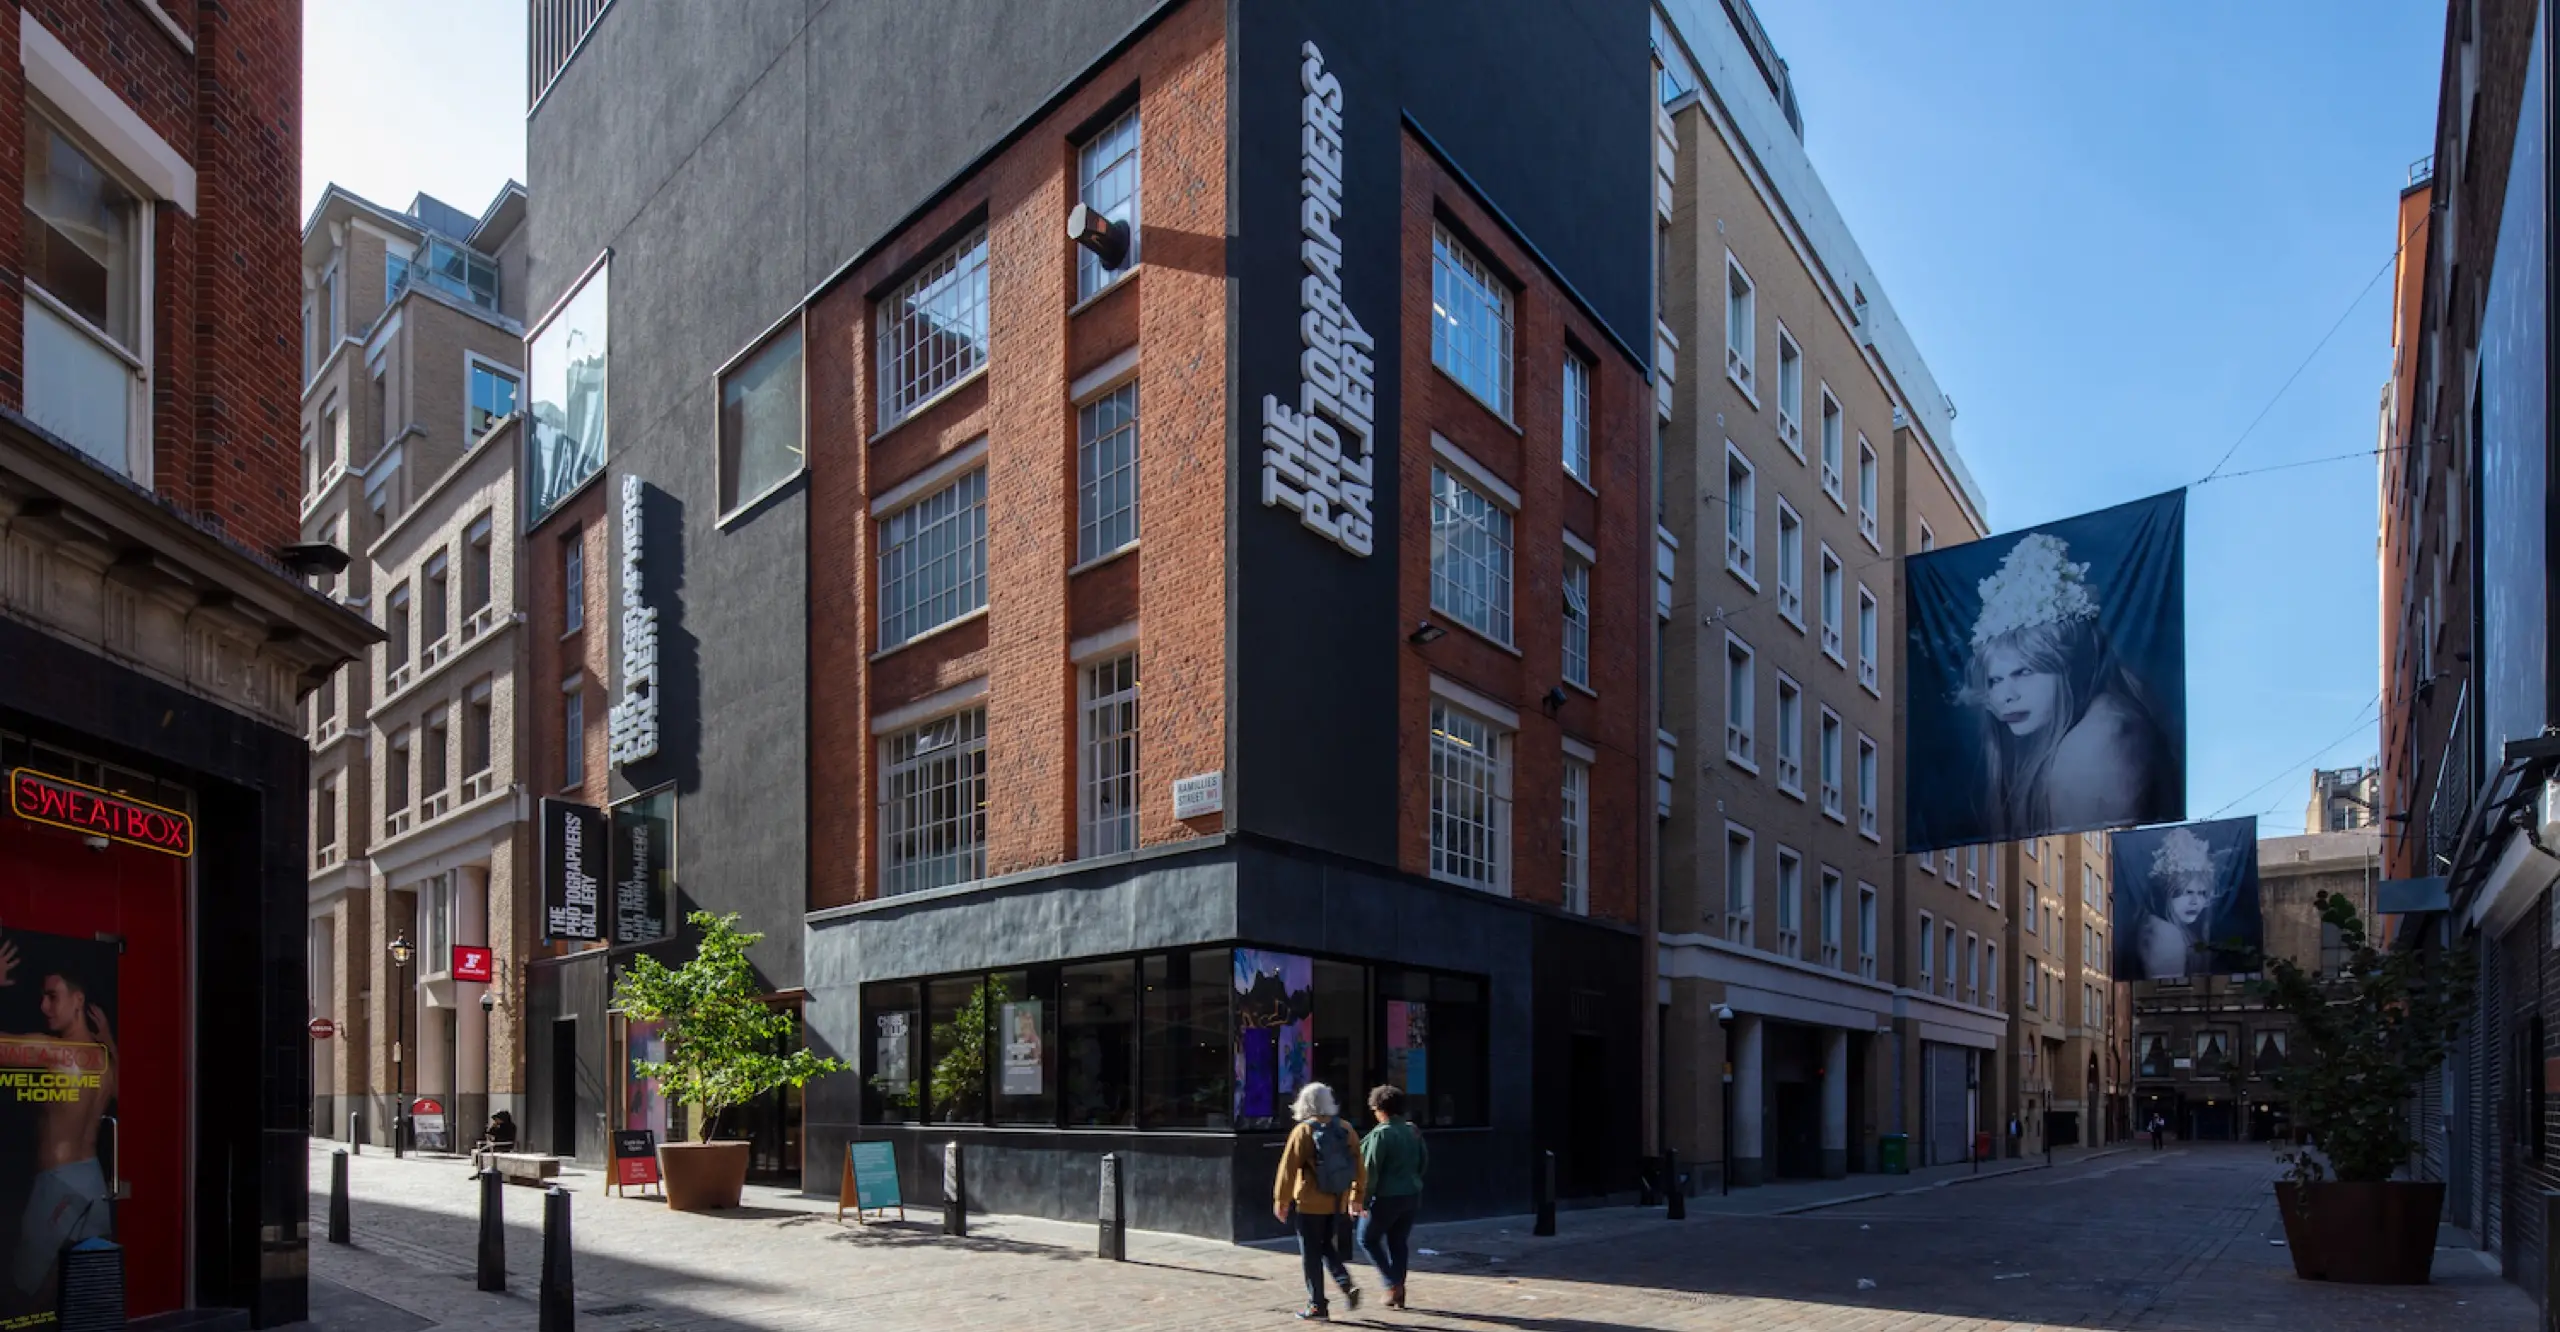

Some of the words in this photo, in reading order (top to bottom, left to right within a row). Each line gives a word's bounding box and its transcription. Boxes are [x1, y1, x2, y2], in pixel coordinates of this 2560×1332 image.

[1262, 393, 1305, 513] THE
[1339, 302, 1375, 558] GALLERY
[637, 606, 658, 760] GALLERY
[609, 703, 625, 771] THE
[20, 778, 184, 848] SWEATBOX
[549, 906, 566, 935] THE
[581, 873, 597, 938] GALLERY
[0, 1073, 101, 1088] WELCOME
[16, 1088, 80, 1102] HOME
